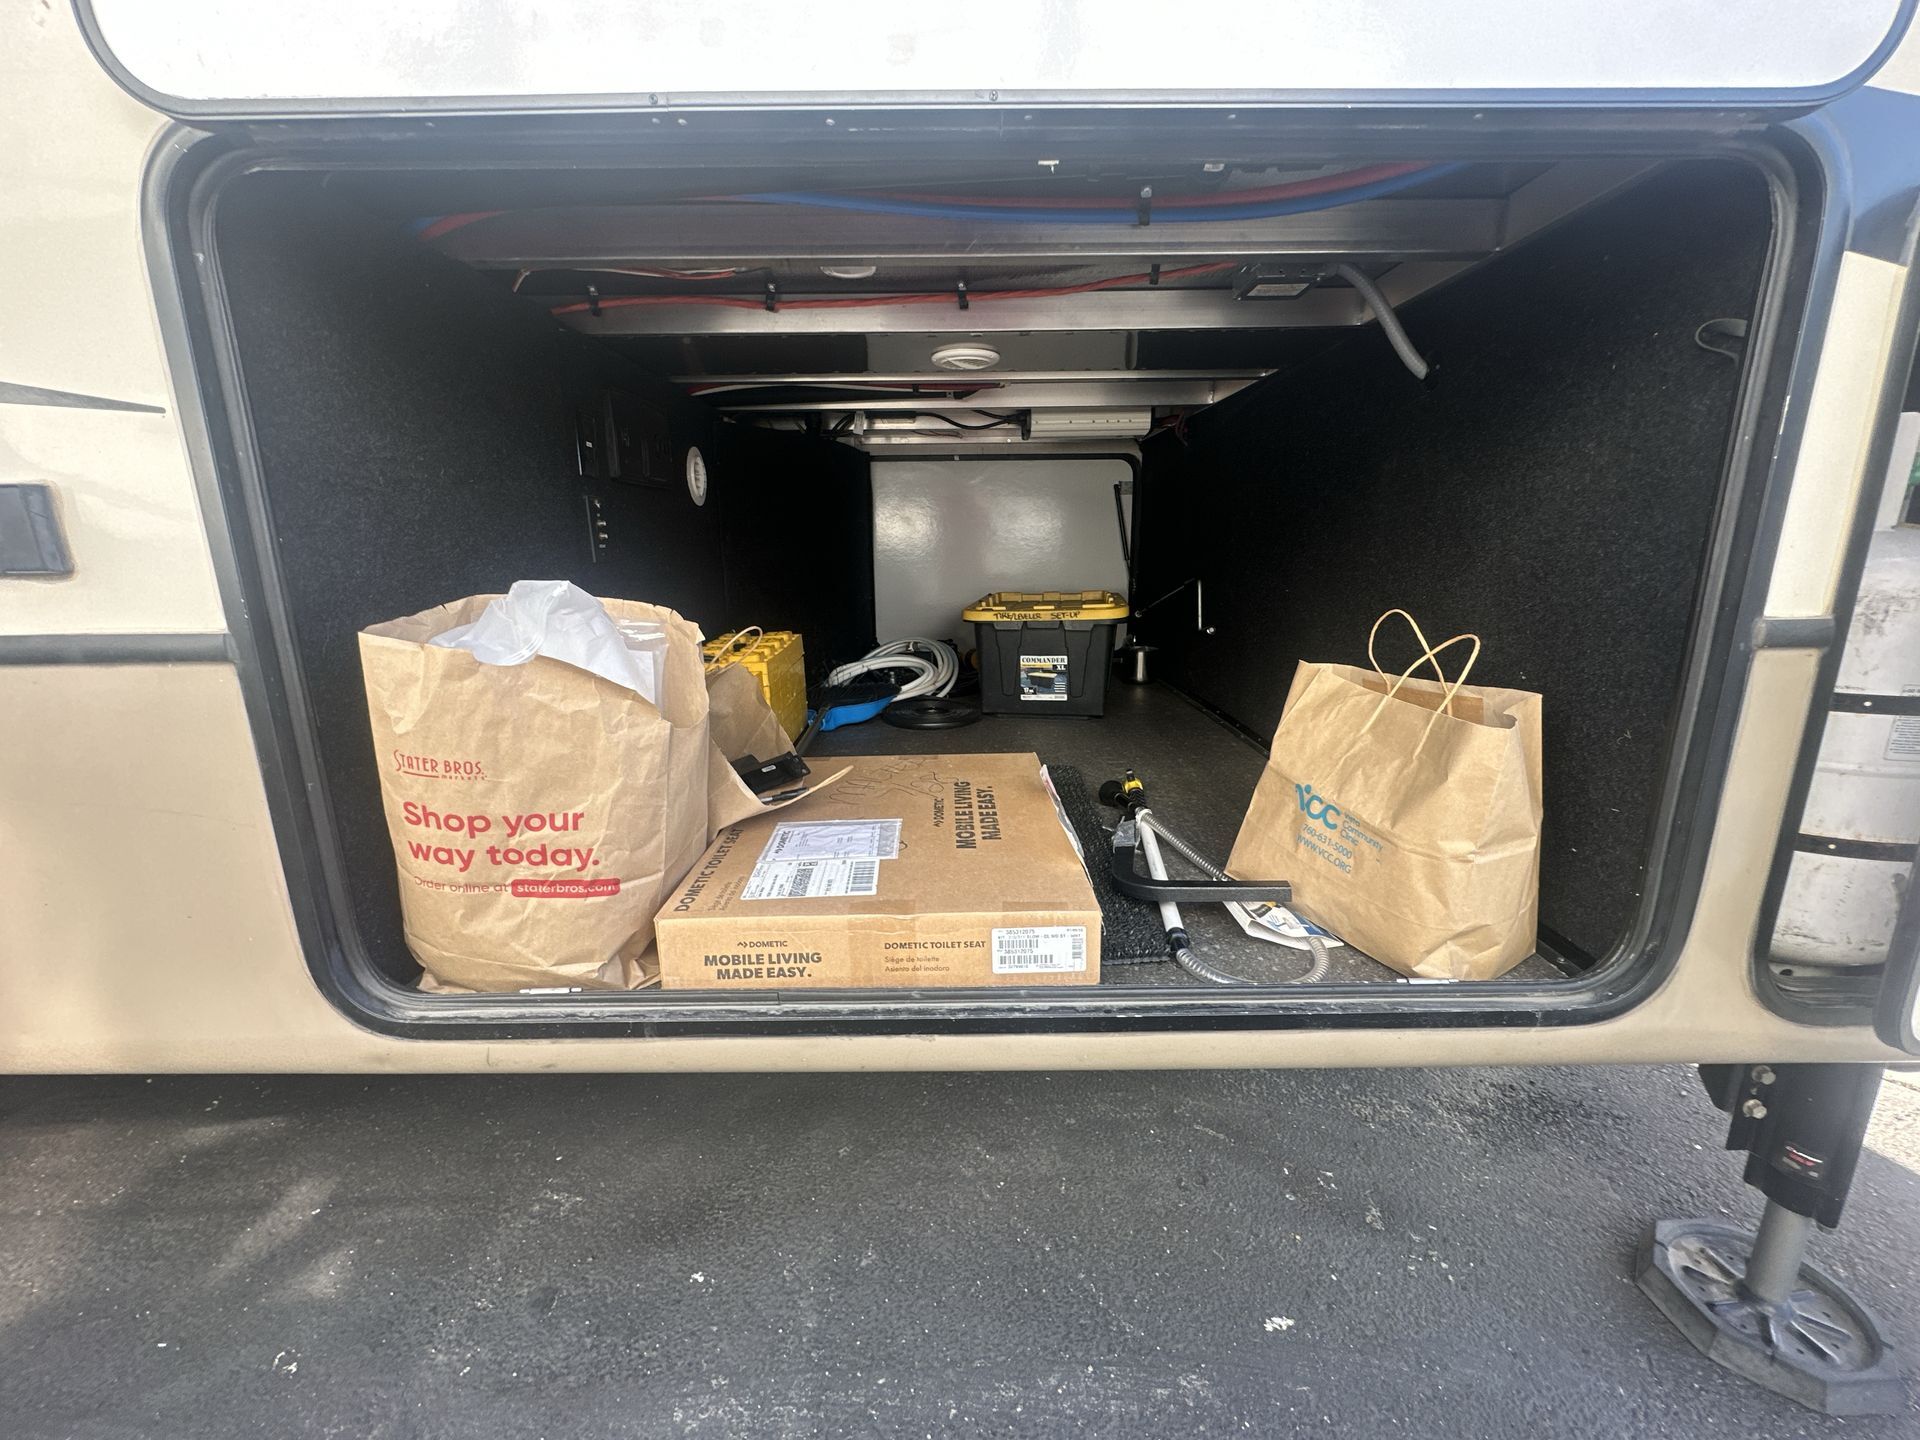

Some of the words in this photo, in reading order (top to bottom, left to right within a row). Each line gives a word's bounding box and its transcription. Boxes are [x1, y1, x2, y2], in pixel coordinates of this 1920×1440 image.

[1050, 611, 1080, 619] SET-UP
[393, 749, 439, 773] STATER
[444, 760, 485, 775] BROS.
[953, 781, 974, 809] LIVING
[976, 785, 997, 810] EASY.
[402, 801, 491, 839] Shop
[502, 811, 584, 838] your
[933, 797, 944, 822] DOMETIC
[955, 810, 977, 850] MOBILE
[978, 810, 1002, 841] MADE
[1340, 829, 1360, 847] Clinic
[1342, 820, 1384, 851] Community
[1296, 834, 1352, 874] WWW.VCC.ORG
[1302, 823, 1353, 860] 760-631-5000
[407, 840, 475, 872] way
[486, 843, 600, 872] today.
[673, 870, 716, 912] DOMETIC
[704, 844, 733, 872] TOILET
[725, 828, 745, 848] SEAT
[413, 875, 446, 891] Order
[449, 881, 490, 894] online
[493, 883, 509, 893] at
[516, 882, 616, 894] staterbros.com
[749, 940, 788, 948] DOMETIC
[884, 941, 929, 950] DOMETIC
[930, 941, 962, 949] TOILET
[963, 940, 986, 948] SEAT
[704, 953, 765, 966] MOBILE
[768, 952, 822, 965] LIVING
[884, 955, 905, 964] Siège
[716, 967, 764, 980] MADE
[766, 966, 812, 978] EASY.
